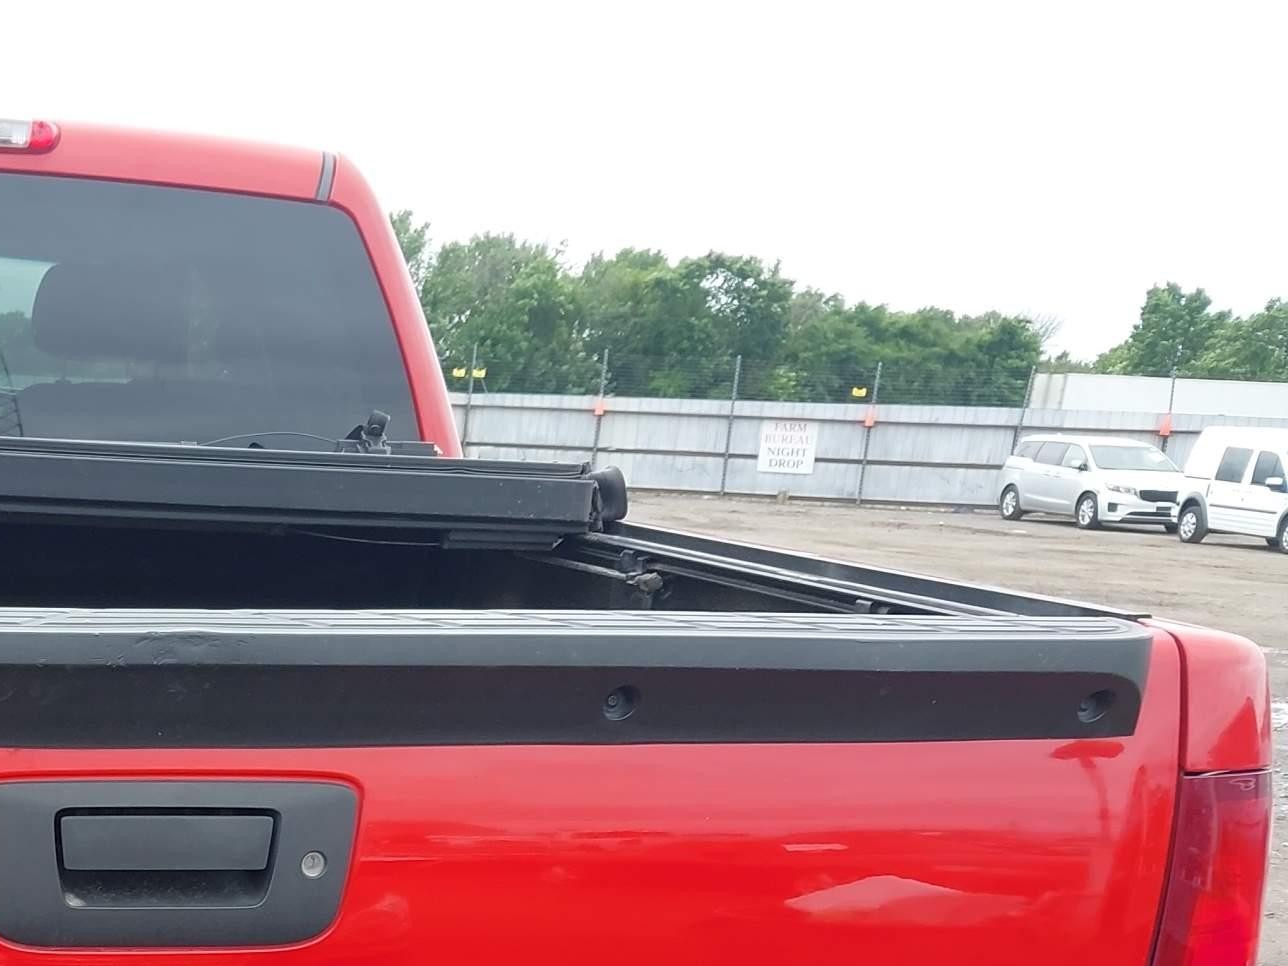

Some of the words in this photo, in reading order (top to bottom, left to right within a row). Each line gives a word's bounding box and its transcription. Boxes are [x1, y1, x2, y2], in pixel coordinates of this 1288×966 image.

[775, 422, 808, 432] FARM
[767, 447, 807, 457] NIGHT
[768, 458, 804, 469] DROP
